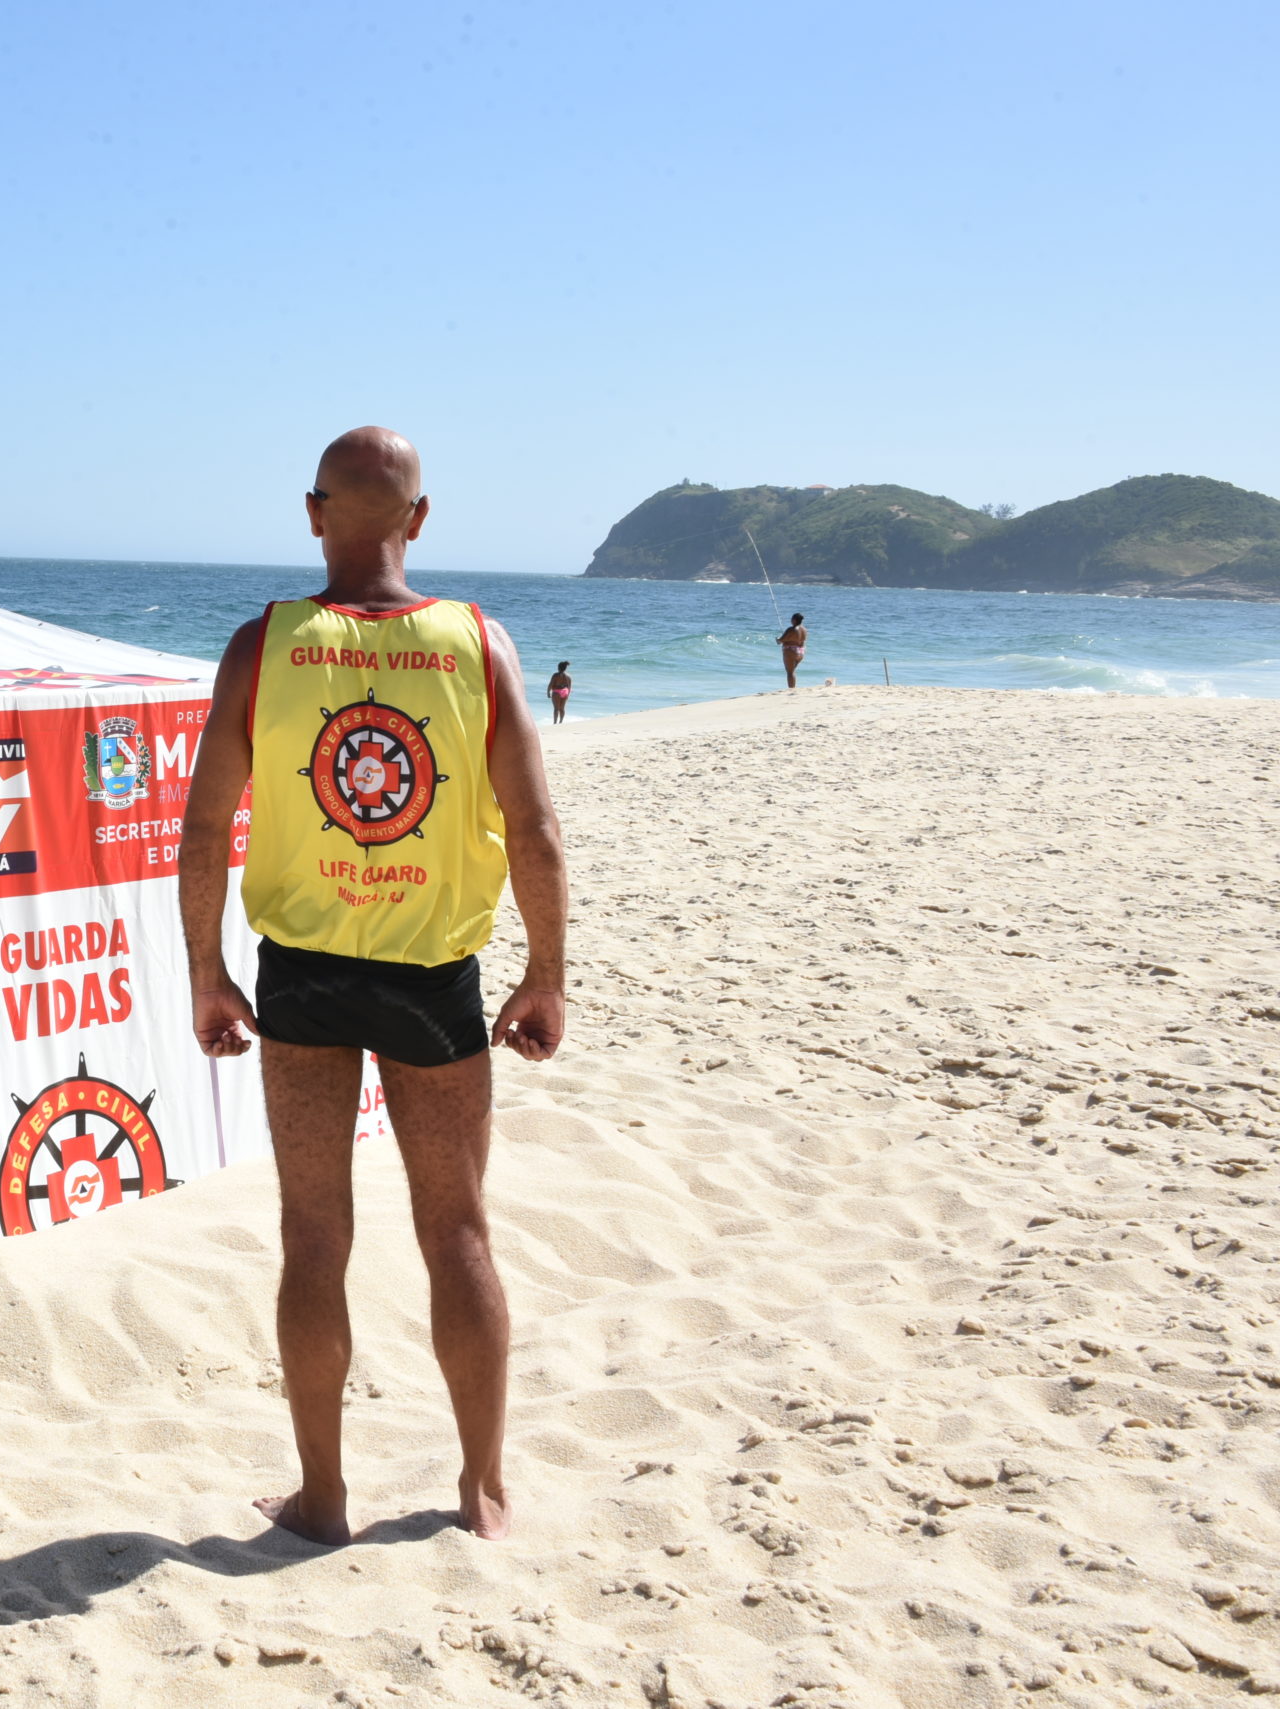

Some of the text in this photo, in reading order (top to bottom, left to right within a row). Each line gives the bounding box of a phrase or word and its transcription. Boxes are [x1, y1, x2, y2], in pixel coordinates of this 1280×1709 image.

[290, 646, 457, 673] GUARDA VIDAS
[388, 718, 425, 762] CIVIL
[320, 775, 339, 809] CORPO
[337, 808, 349, 821] DE
[147, 847, 158, 864] E
[319, 859, 427, 886] LIFE GUARD
[388, 891, 405, 904] RJ
[0, 918, 130, 974] GUARDA
[1, 967, 132, 1042] VIDAS
[9, 1090, 151, 1194] DEFESA CIVIL
